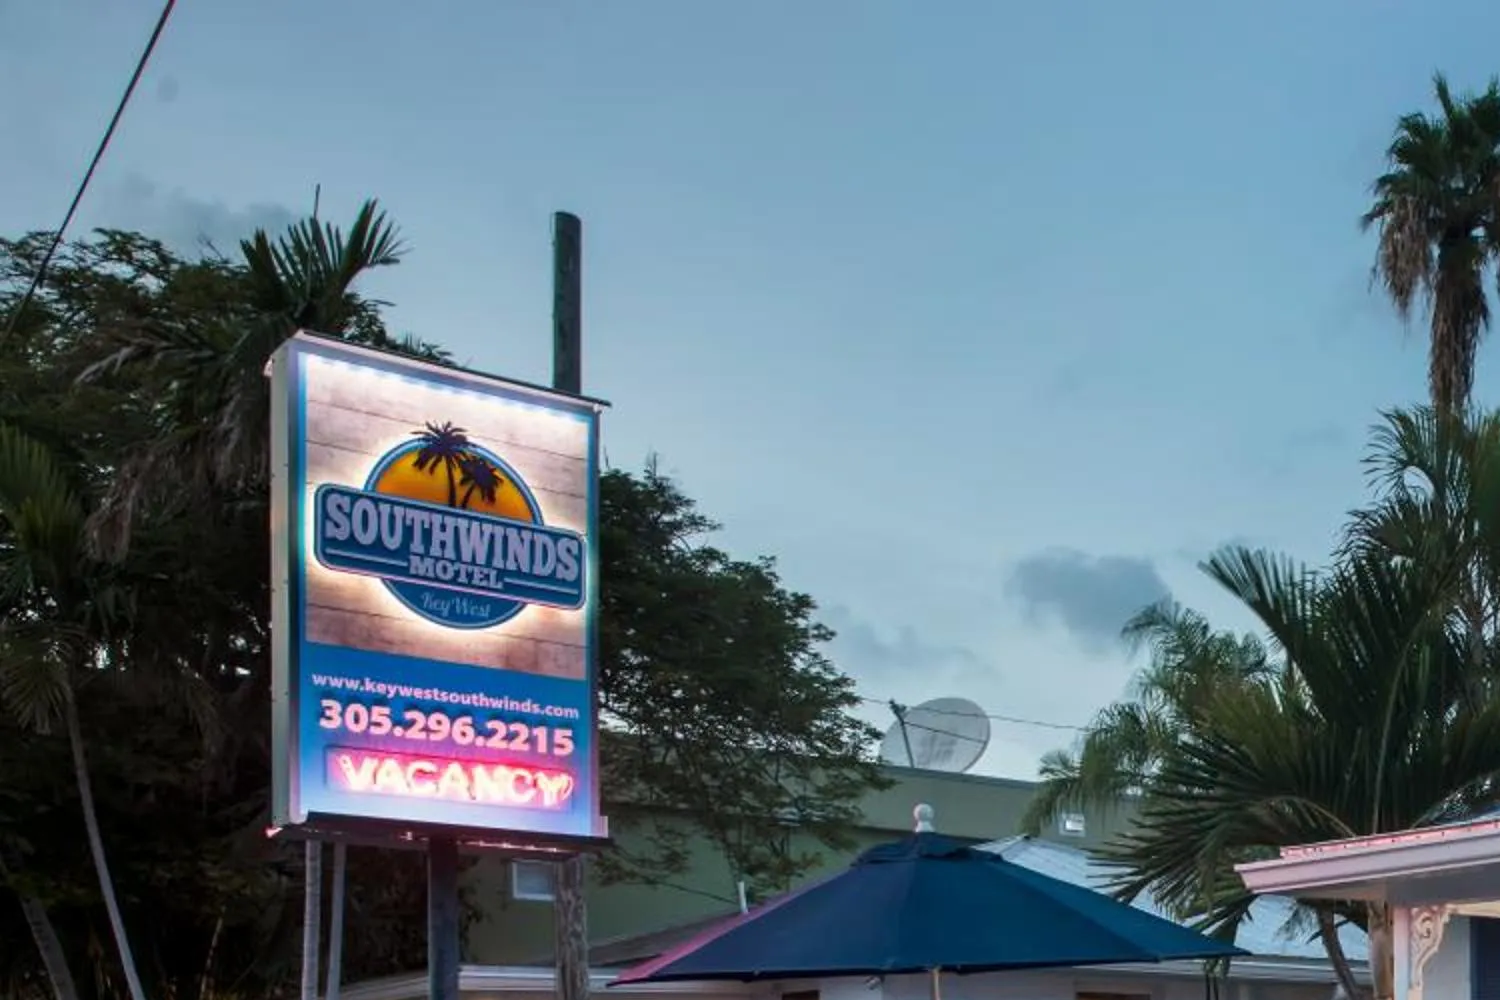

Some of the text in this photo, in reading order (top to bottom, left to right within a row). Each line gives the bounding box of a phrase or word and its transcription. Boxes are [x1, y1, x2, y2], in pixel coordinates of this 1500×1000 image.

[324, 492, 579, 582] SOUTHWINDS
[409, 554, 503, 589] MOTEL
[420, 592, 491, 618] Key West
[312, 672, 580, 720] www.keywestsouthwinds.com
[319, 699, 574, 756] 305.296.2215
[338, 754, 574, 806] VACANCY
